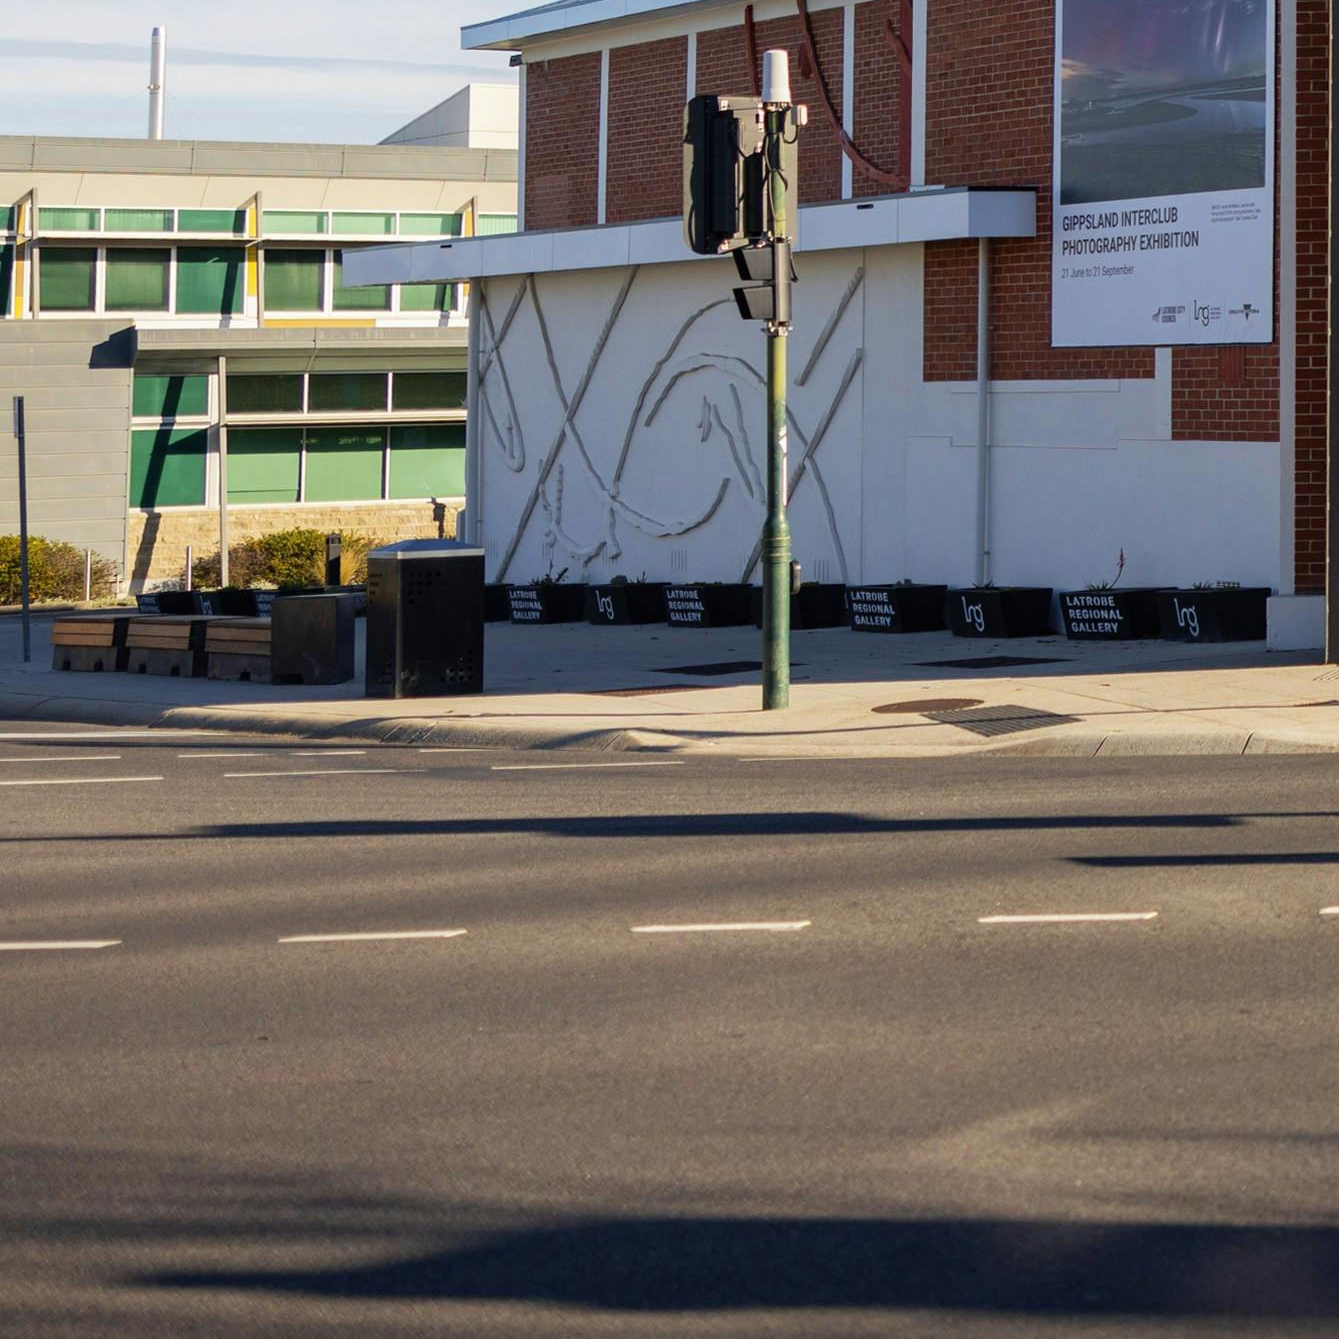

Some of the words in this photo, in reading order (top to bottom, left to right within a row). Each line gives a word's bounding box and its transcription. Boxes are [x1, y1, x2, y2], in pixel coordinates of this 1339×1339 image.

[1063, 212, 1118, 231] GIPPSLAND
[1121, 207, 1178, 227] INTERCLUB
[1062, 235, 1137, 256] PHOTOGRAPHY
[1140, 231, 1199, 250] EXHIBITION
[1062, 268, 1069, 278] 21
[1070, 267, 1084, 278] June
[1086, 268, 1093, 277] to
[1093, 267, 1101, 277] 21
[1102, 264, 1134, 278] September
[509, 590, 537, 600] LATROBE
[667, 590, 698, 600] LATROBE
[850, 591, 888, 602] LATROBE
[511, 600, 543, 610] REGIONAL
[668, 601, 704, 611] REGIONAL
[1066, 596, 1115, 607] LATROBE
[852, 603, 896, 615] REGIONAL
[1069, 609, 1124, 620] REGIONAL
[513, 611, 540, 621] GALLERY
[670, 611, 701, 622] GALLERY
[854, 615, 892, 627] GALLERY
[1071, 622, 1119, 633] GALLERY
